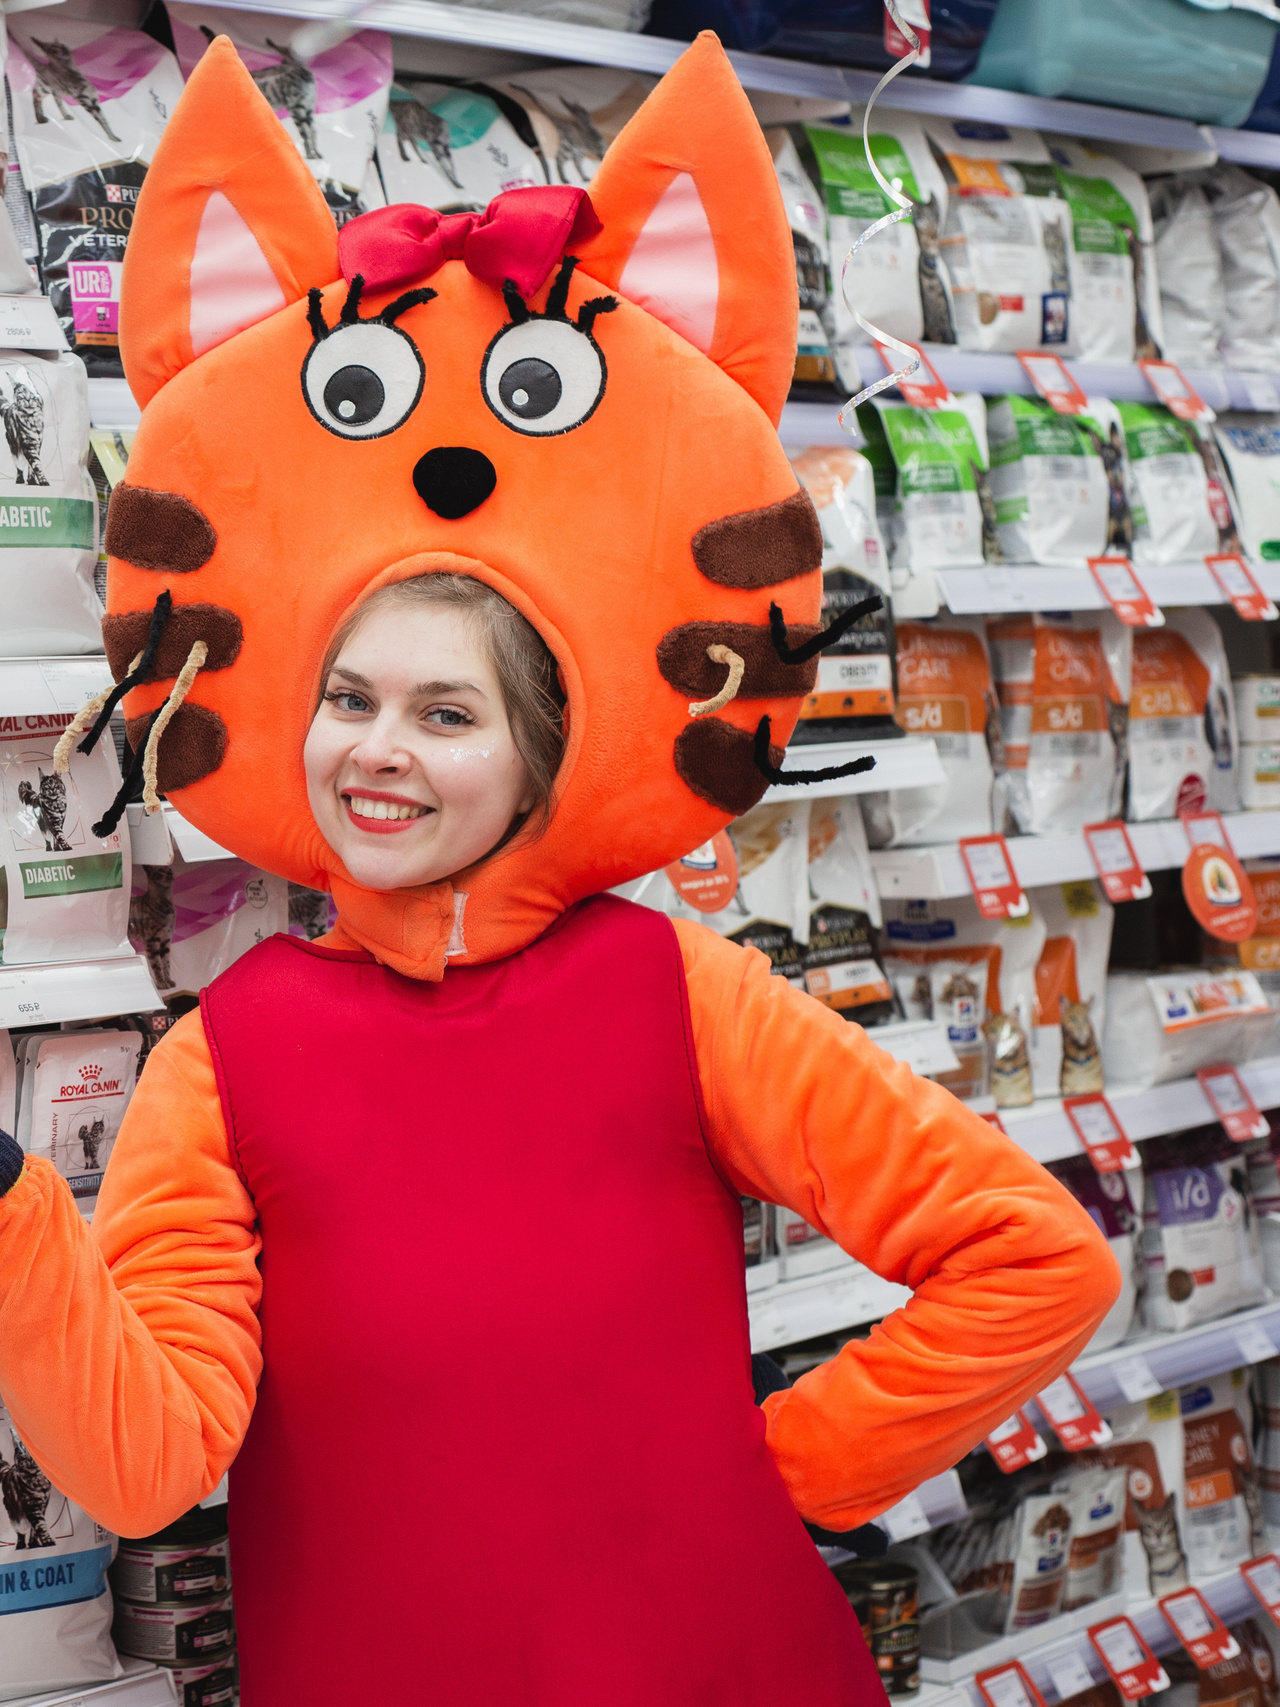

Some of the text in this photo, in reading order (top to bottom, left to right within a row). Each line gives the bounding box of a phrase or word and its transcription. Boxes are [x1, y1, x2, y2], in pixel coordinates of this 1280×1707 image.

[69, 234, 129, 247] VETER
[25, 864, 76, 884] DIABETIC
[59, 1080, 120, 1097] ROYAL CANIN
[20, 1570, 32, 1591] &
[34, 1562, 76, 1590] COAT
